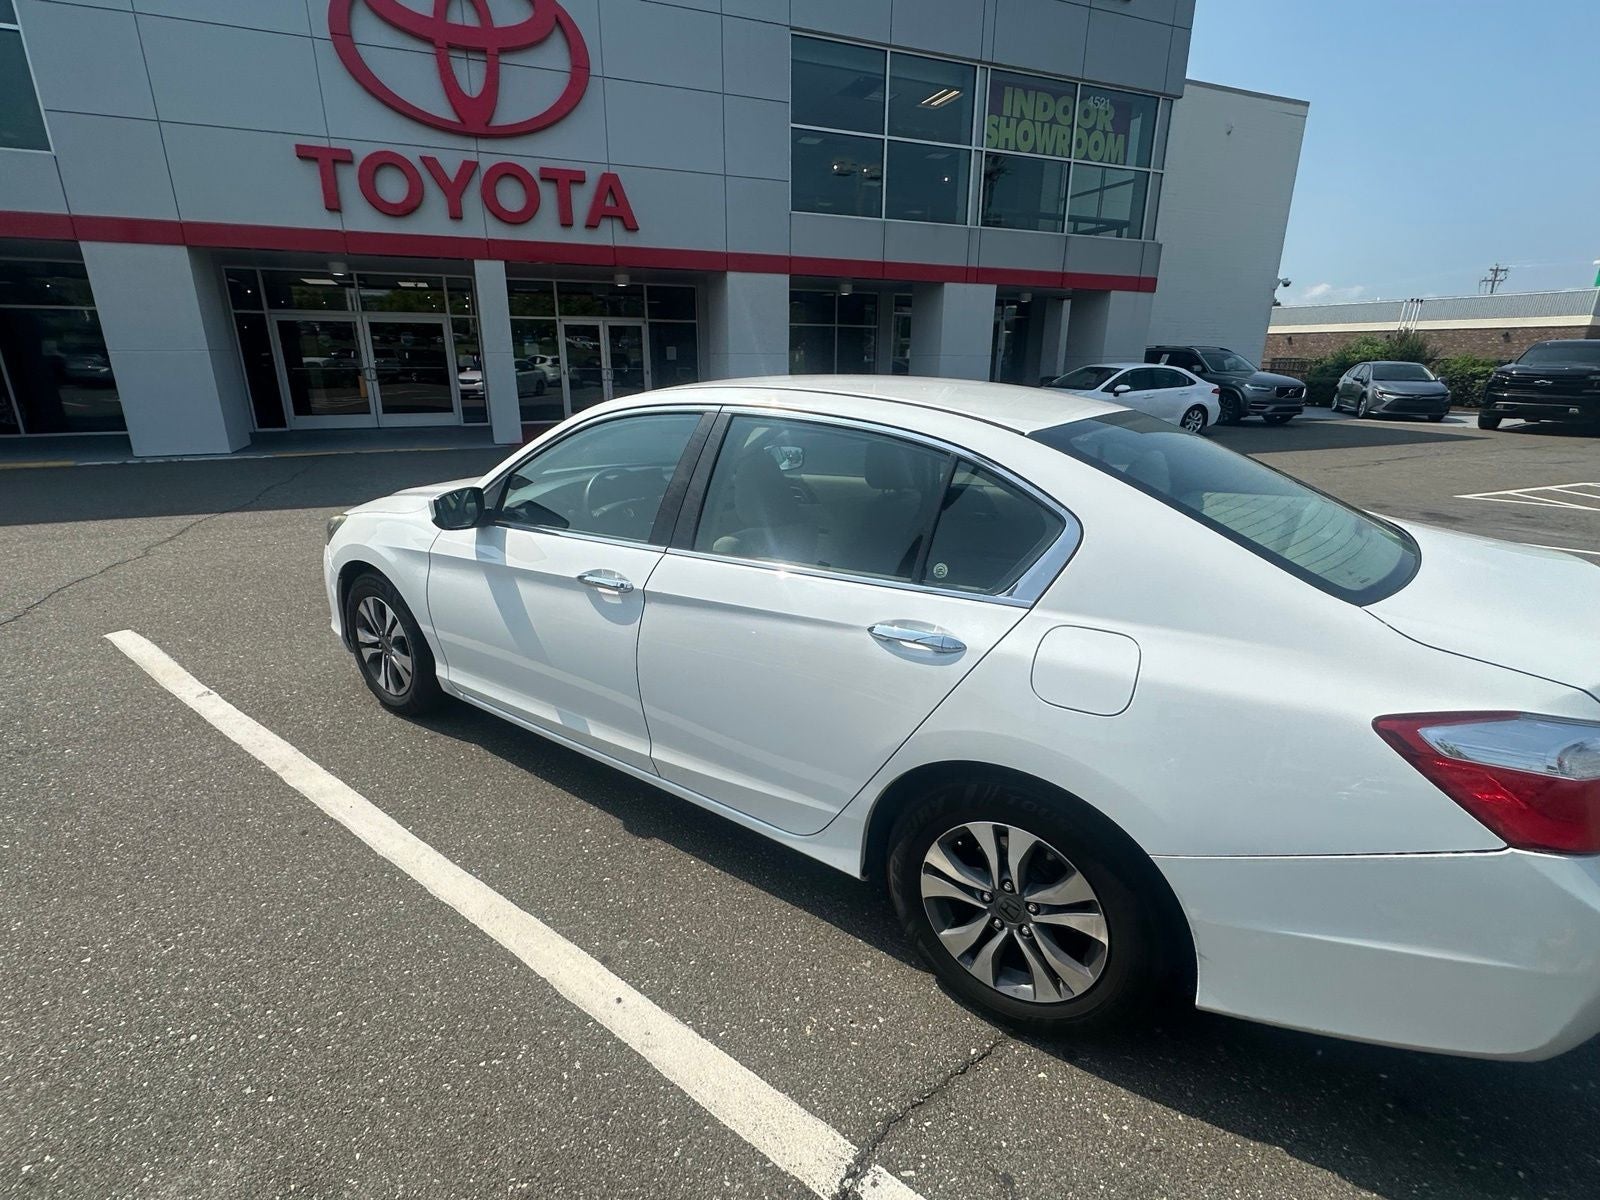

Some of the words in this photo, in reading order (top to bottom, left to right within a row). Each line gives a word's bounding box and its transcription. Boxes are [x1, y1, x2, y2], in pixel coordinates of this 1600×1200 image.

[1003, 86, 1115, 132] INDOOR
[1088, 96, 1110, 112] 4521
[986, 115, 1125, 164] SHOWROOM
[295, 144, 640, 231] TOYOTA
